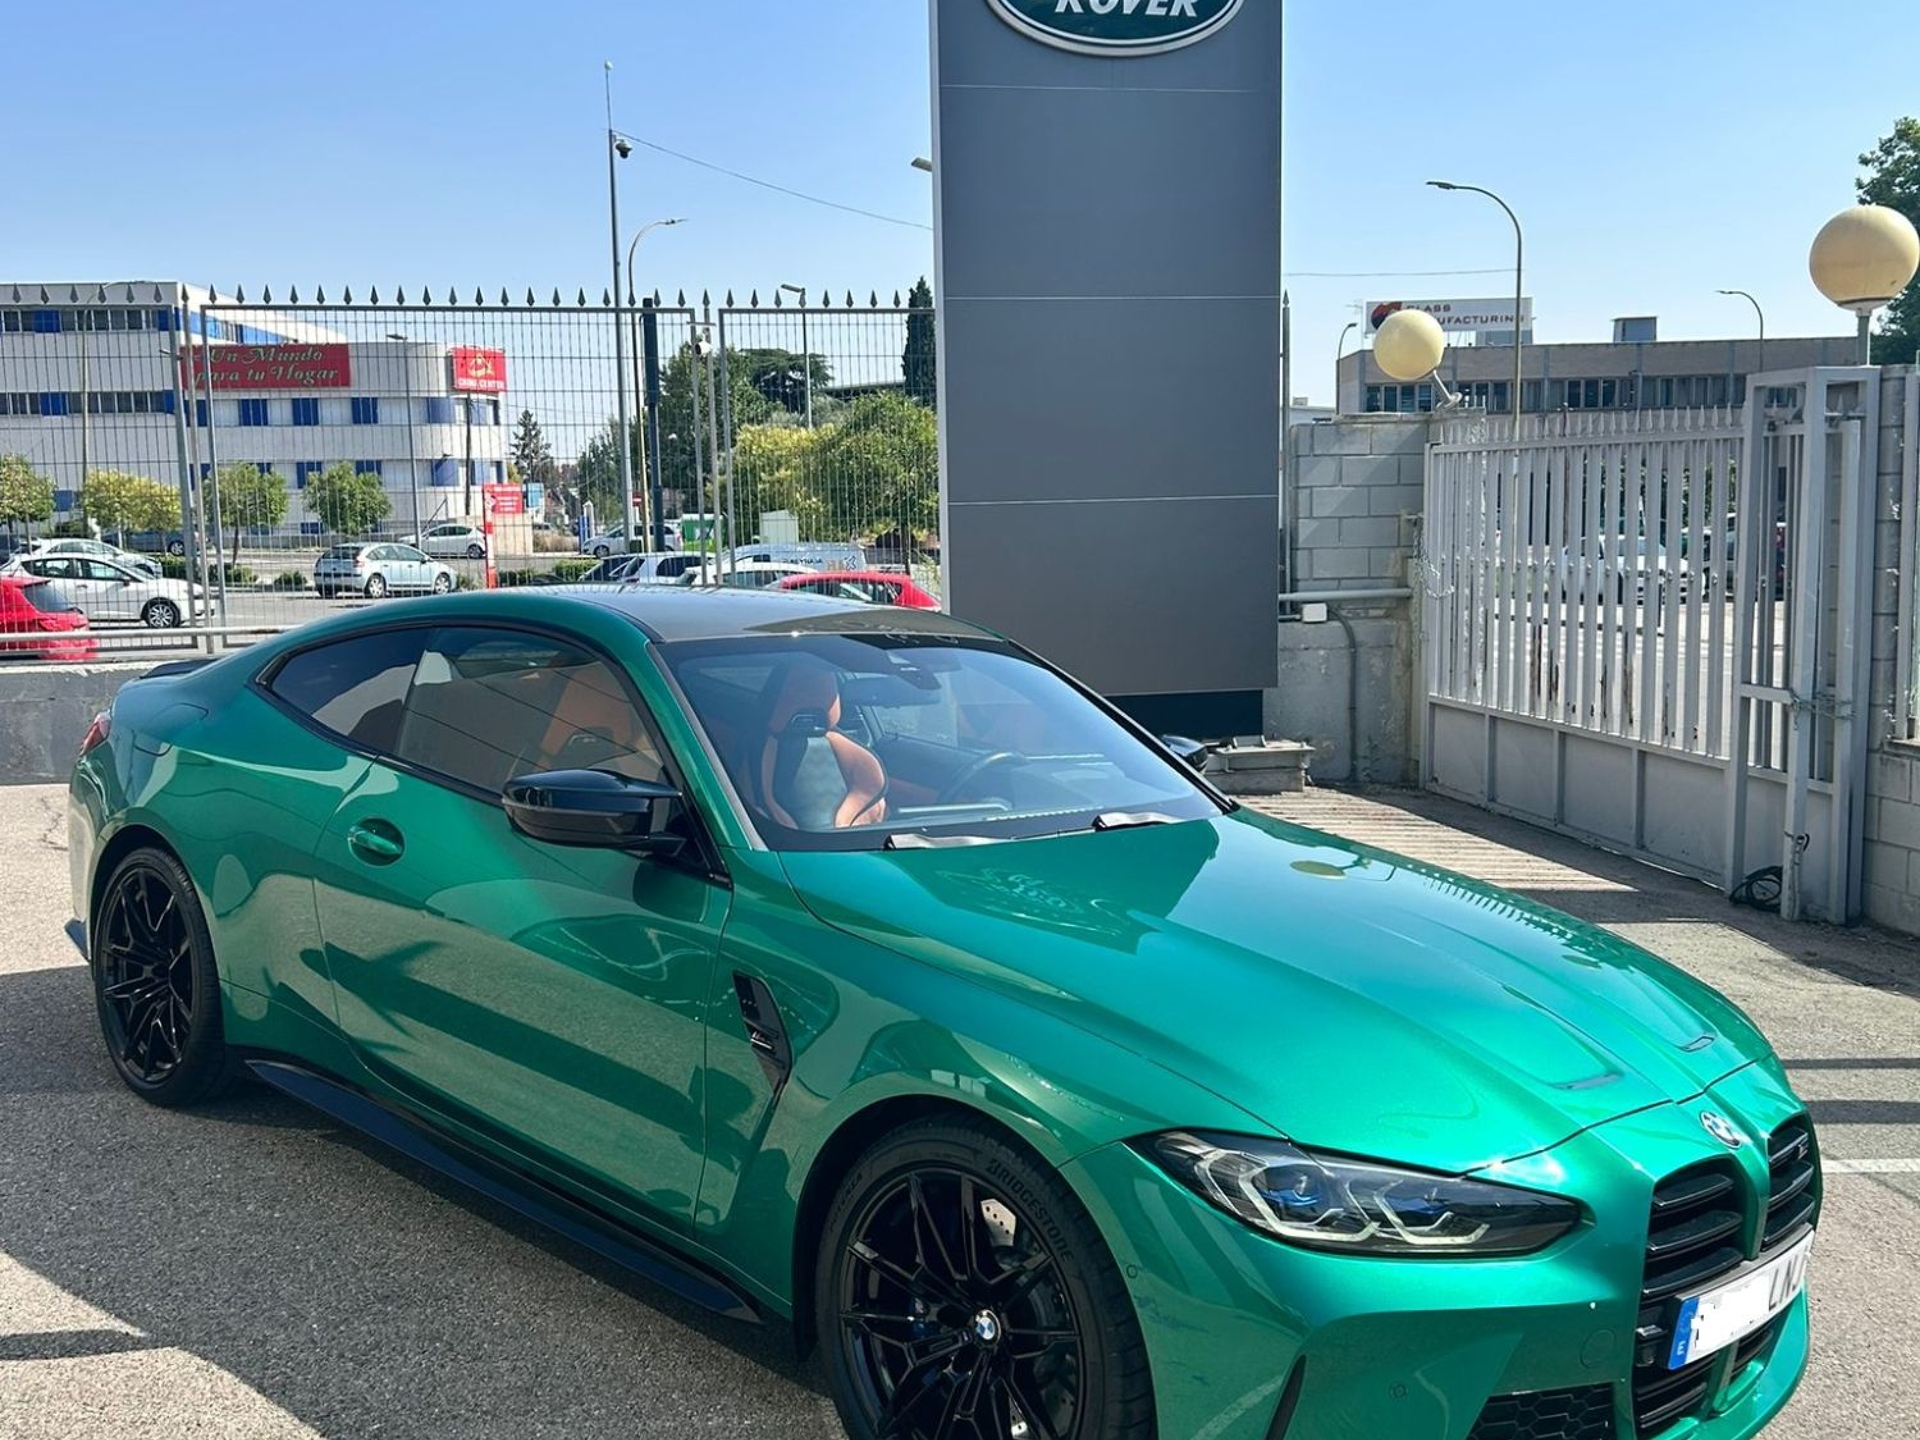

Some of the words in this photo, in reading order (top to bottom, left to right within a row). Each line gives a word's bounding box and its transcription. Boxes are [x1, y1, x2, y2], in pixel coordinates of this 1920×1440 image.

[242, 346, 323, 364] Mundo
[194, 369, 240, 385] para
[247, 368, 266, 381] tu
[270, 363, 339, 386] Hogar
